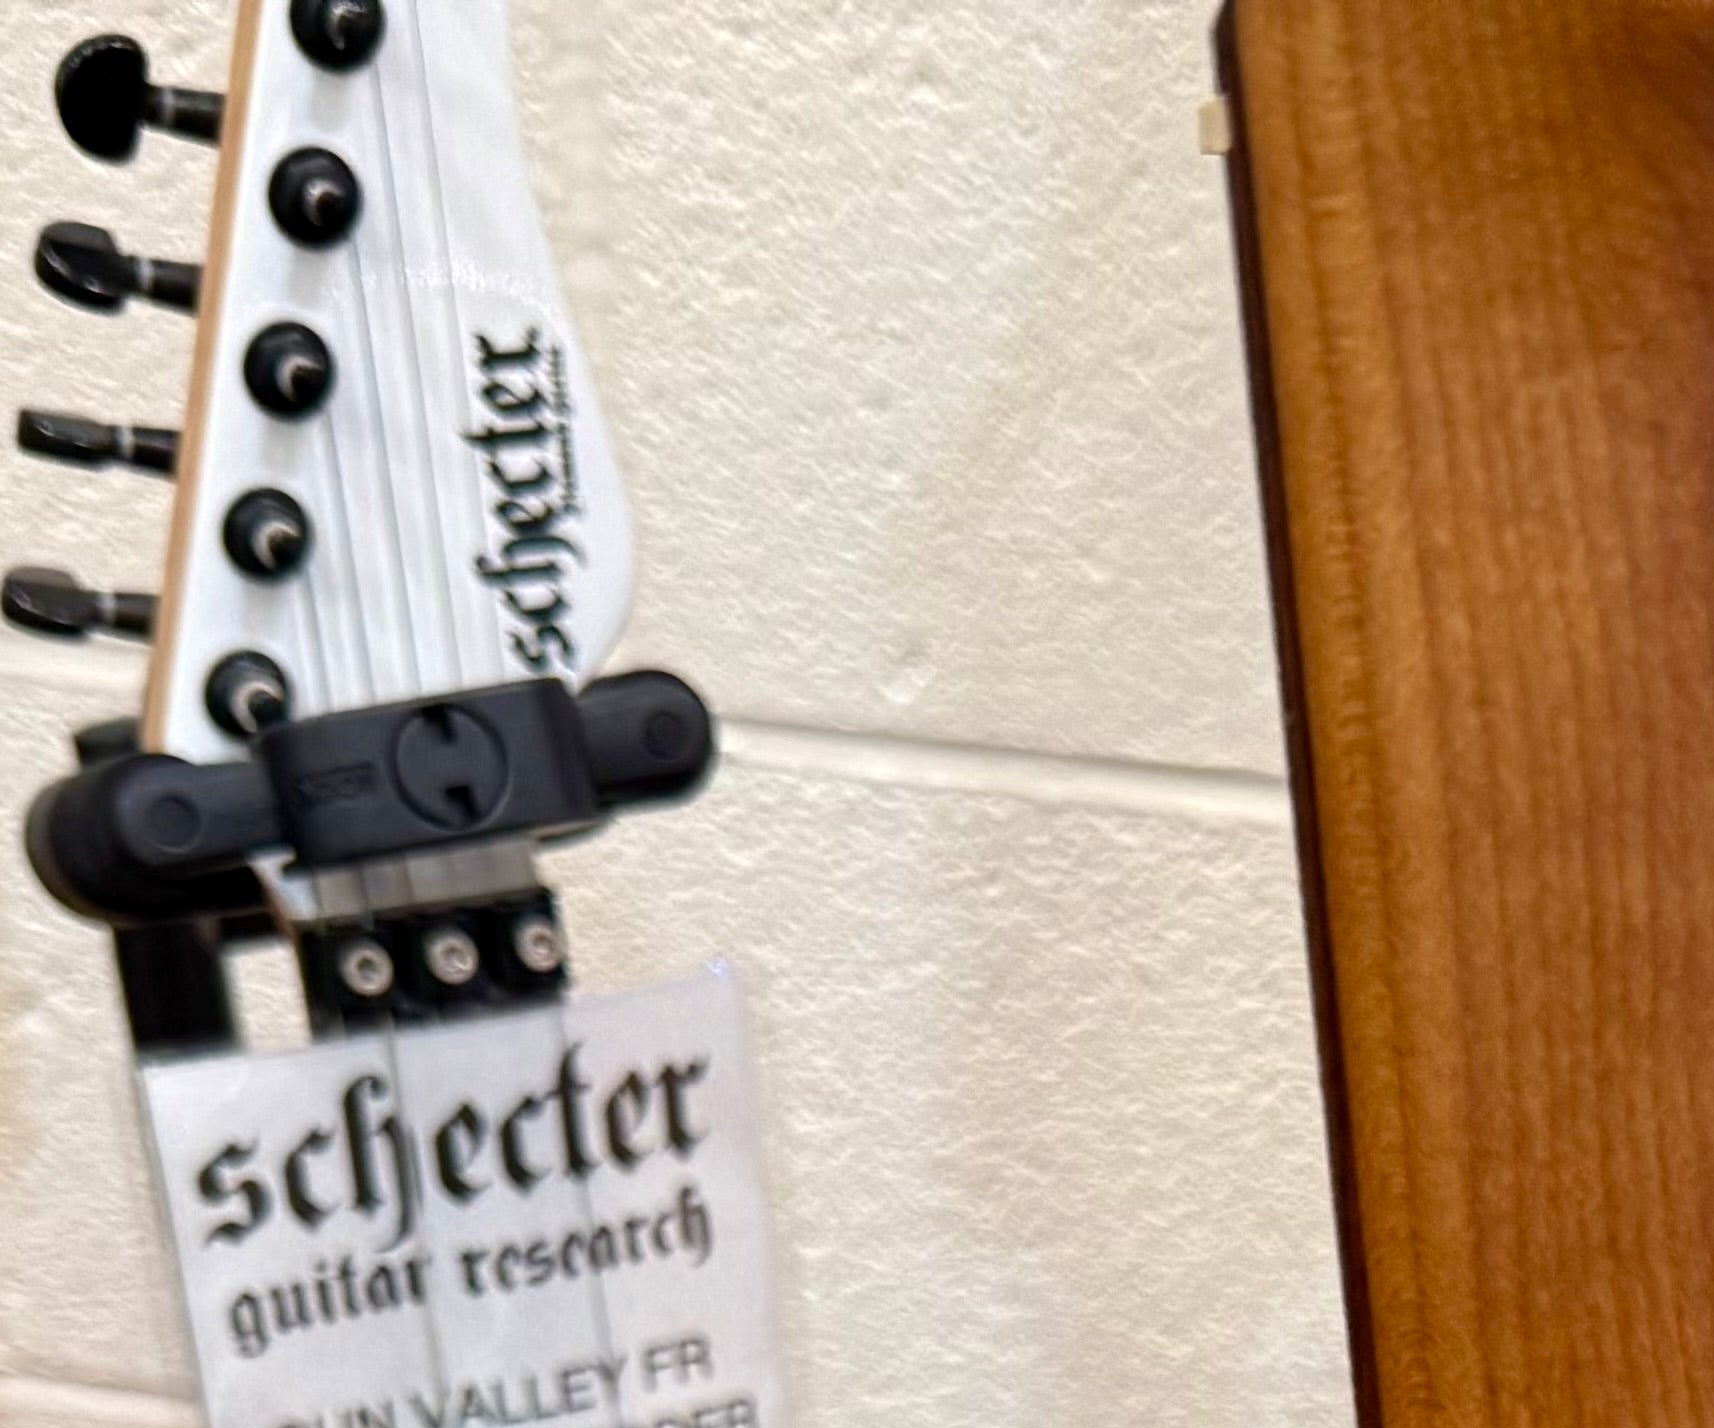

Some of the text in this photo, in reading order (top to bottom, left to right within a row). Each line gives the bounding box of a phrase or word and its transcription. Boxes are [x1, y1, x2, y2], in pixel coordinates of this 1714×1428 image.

[460, 325, 588, 672] schecter
[195, 1040, 712, 1254] schecter
[228, 1182, 714, 1359] guitar research
[640, 1334, 714, 1393] FR
